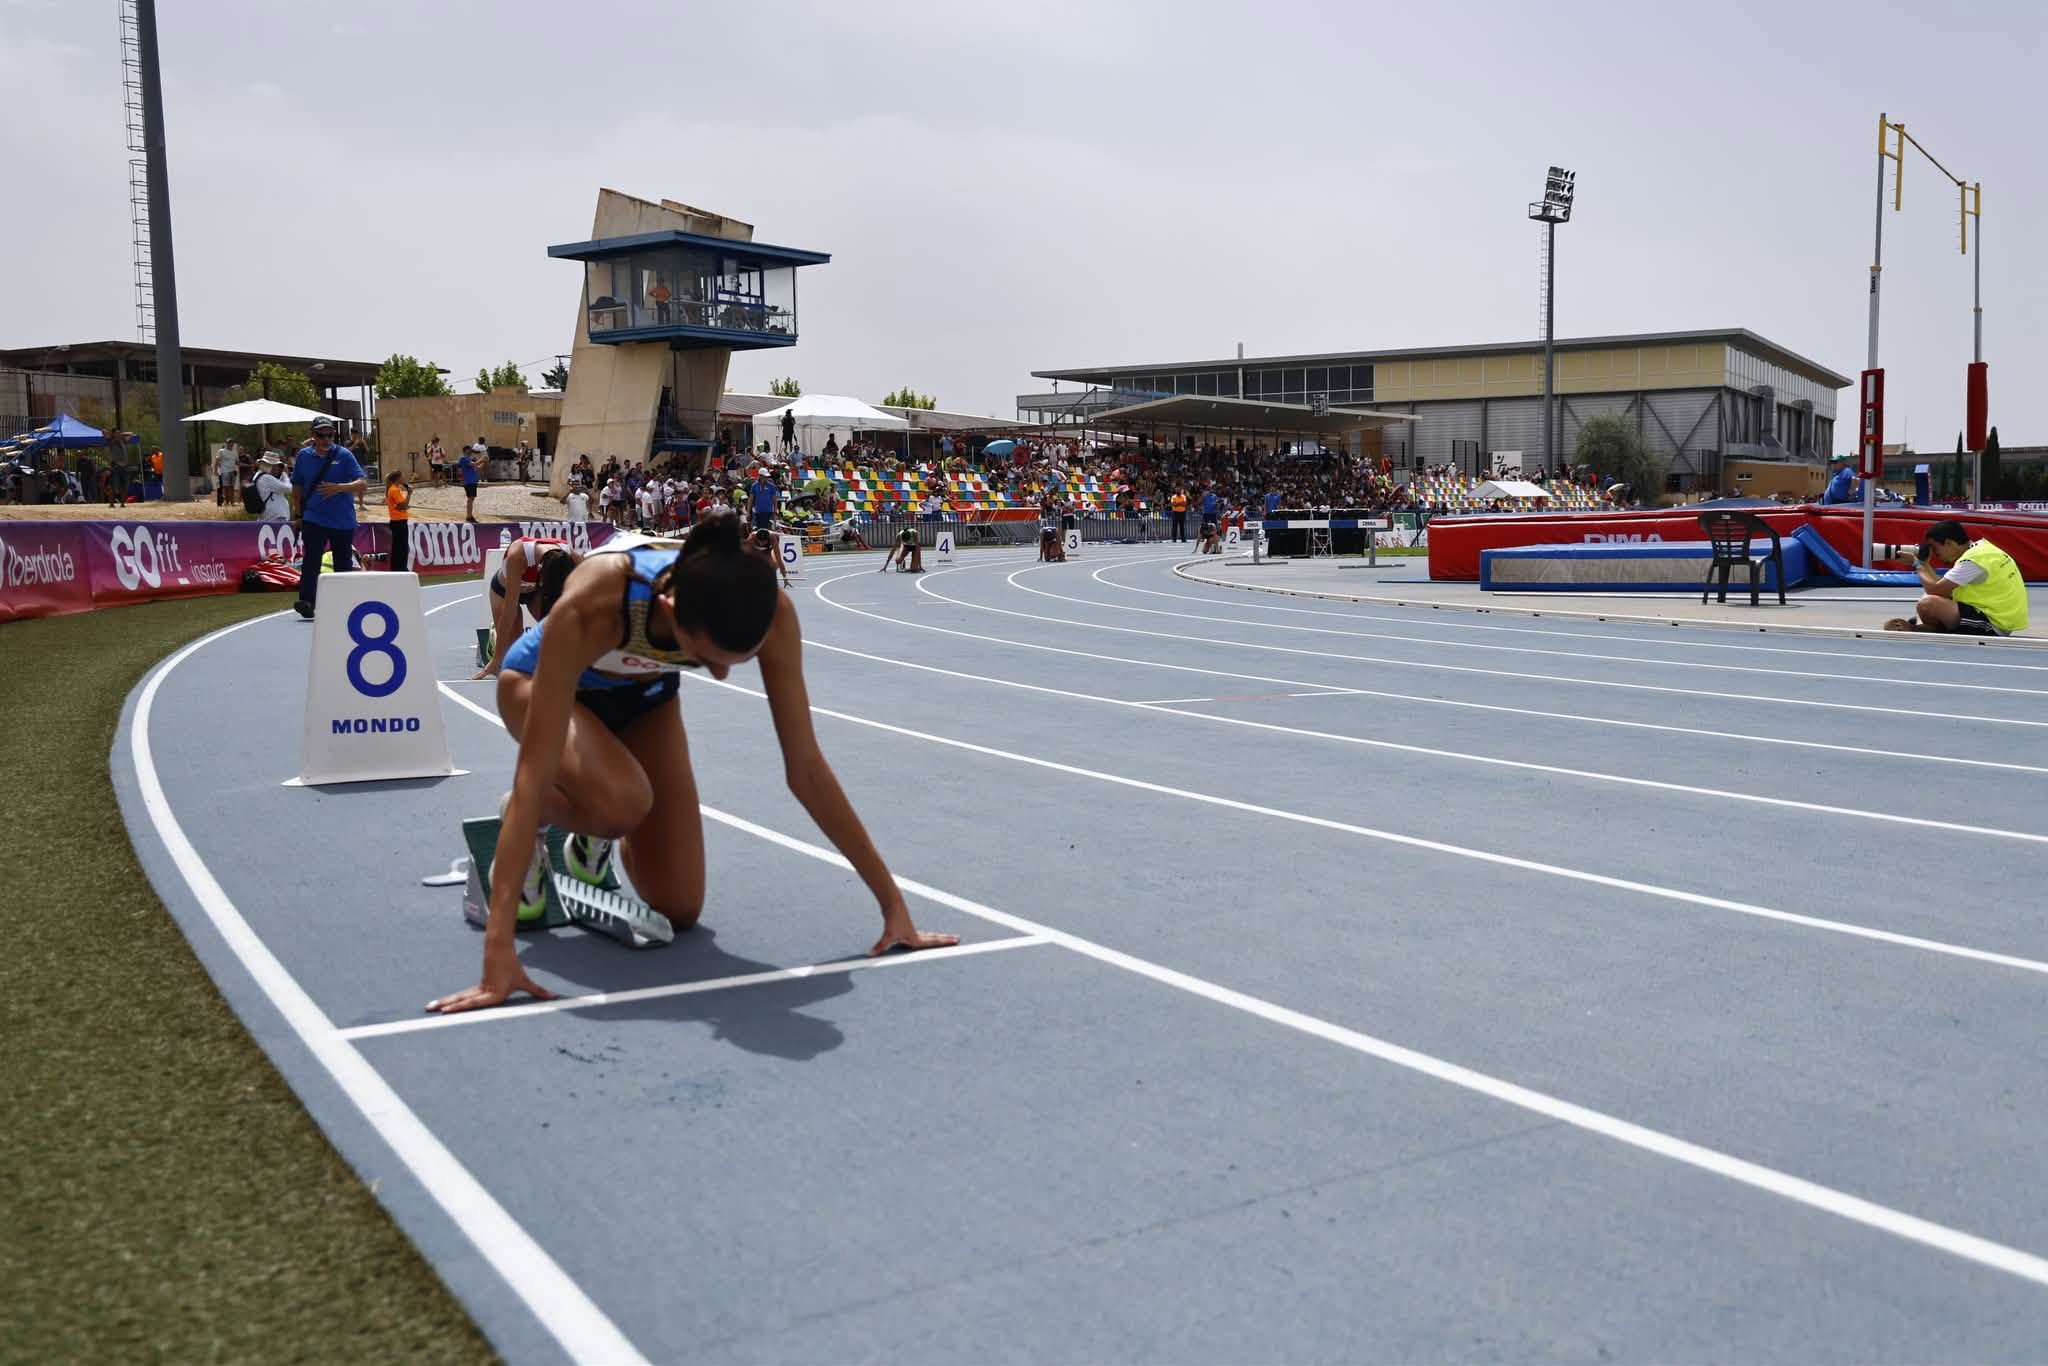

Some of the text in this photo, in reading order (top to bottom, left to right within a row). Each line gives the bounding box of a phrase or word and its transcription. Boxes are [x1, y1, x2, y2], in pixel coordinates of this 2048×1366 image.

[938, 538, 950, 554] 4
[1068, 534, 1078, 549] 3
[1229, 531, 1237, 544] 2
[783, 542, 797, 564] 5
[8, 543, 75, 587] Iberdrola
[189, 557, 227, 588] inspira
[346, 600, 408, 698] 8
[332, 717, 420, 734] MONDO
